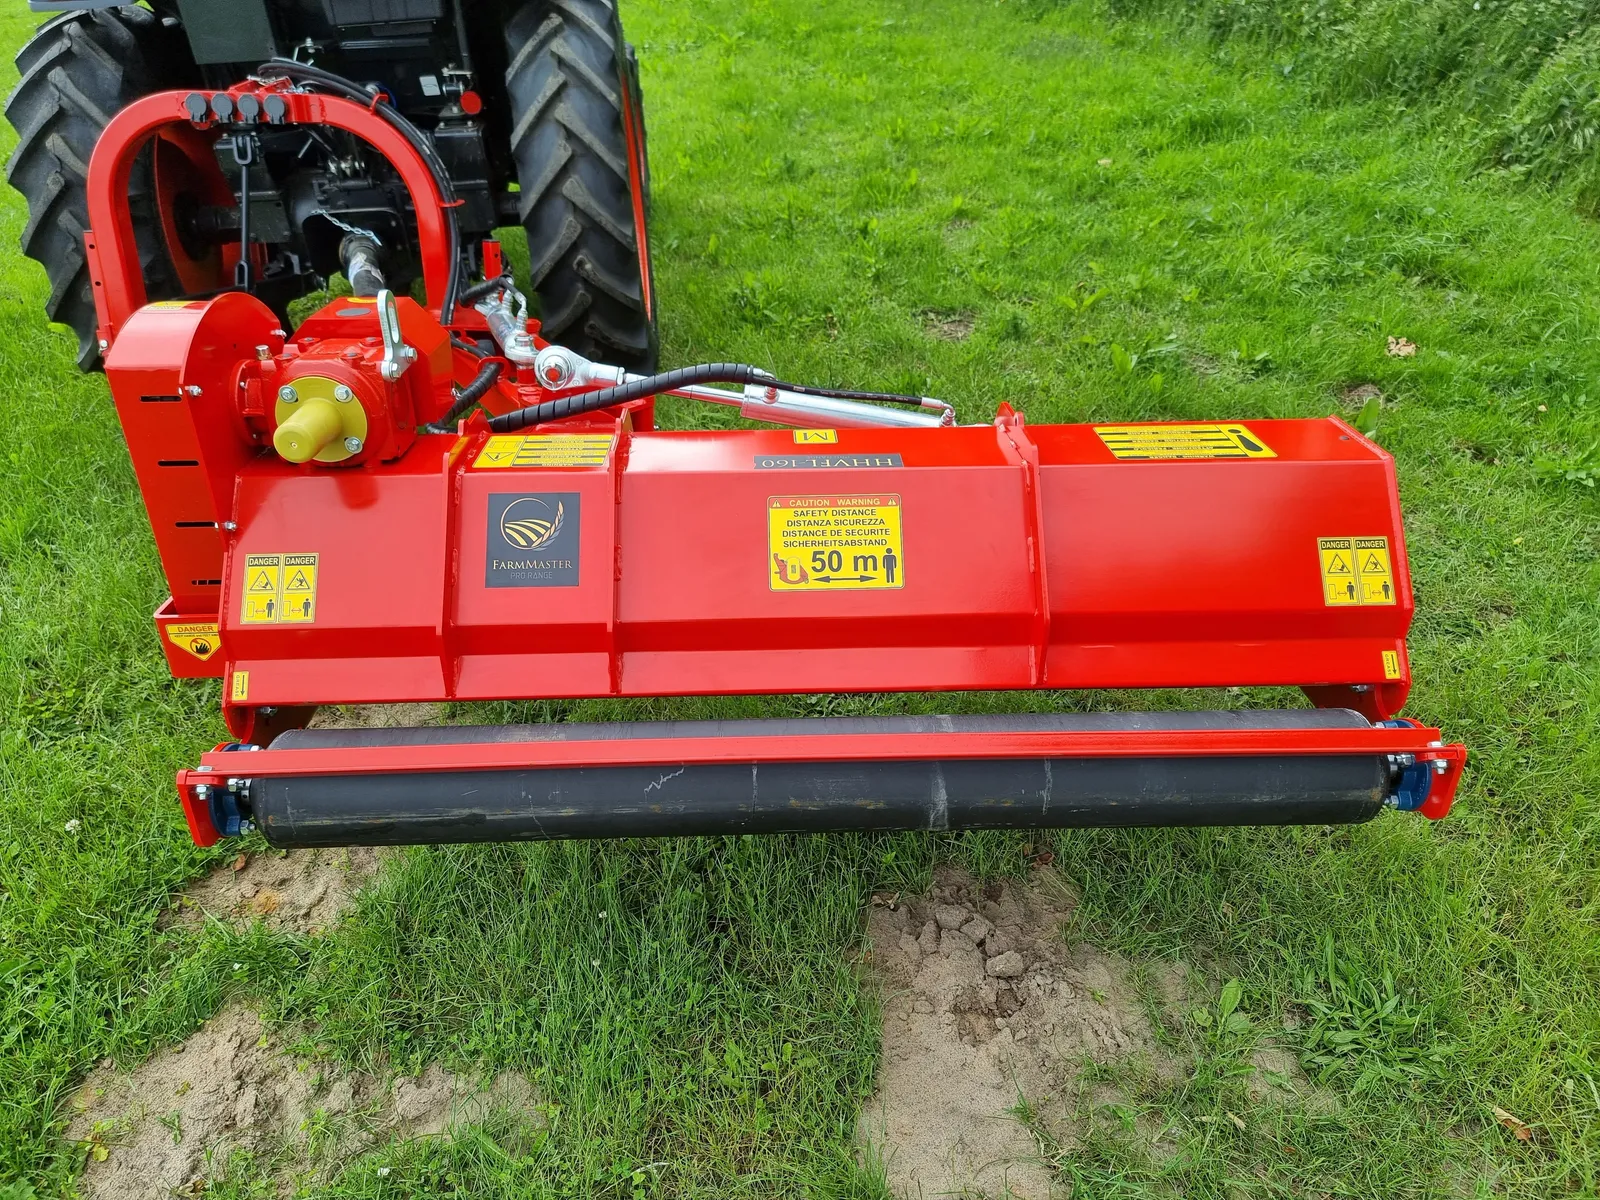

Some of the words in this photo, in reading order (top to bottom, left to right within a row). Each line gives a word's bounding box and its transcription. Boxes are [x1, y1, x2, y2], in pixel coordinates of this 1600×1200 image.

[803, 432, 828, 441] M
[789, 499, 830, 507] CAUTION
[837, 498, 881, 506] WARNING
[793, 509, 828, 518] SAFETY
[831, 508, 877, 516] DISTANCE
[786, 519, 832, 527] DISTANZA
[833, 518, 886, 526] SICUREZZA
[782, 529, 827, 538] DISTANCE
[830, 529, 842, 537] DE
[844, 528, 891, 536] SECURITE
[783, 539, 888, 548] SICHERHEITSABSTAND
[1321, 541, 1350, 549] DANGER
[1356, 540, 1385, 548] DANGER
[249, 557, 279, 566] DANGER
[285, 556, 315, 565] DANGER
[811, 549, 843, 573] 50
[853, 554, 878, 572] m
[177, 625, 214, 633] DANGER
